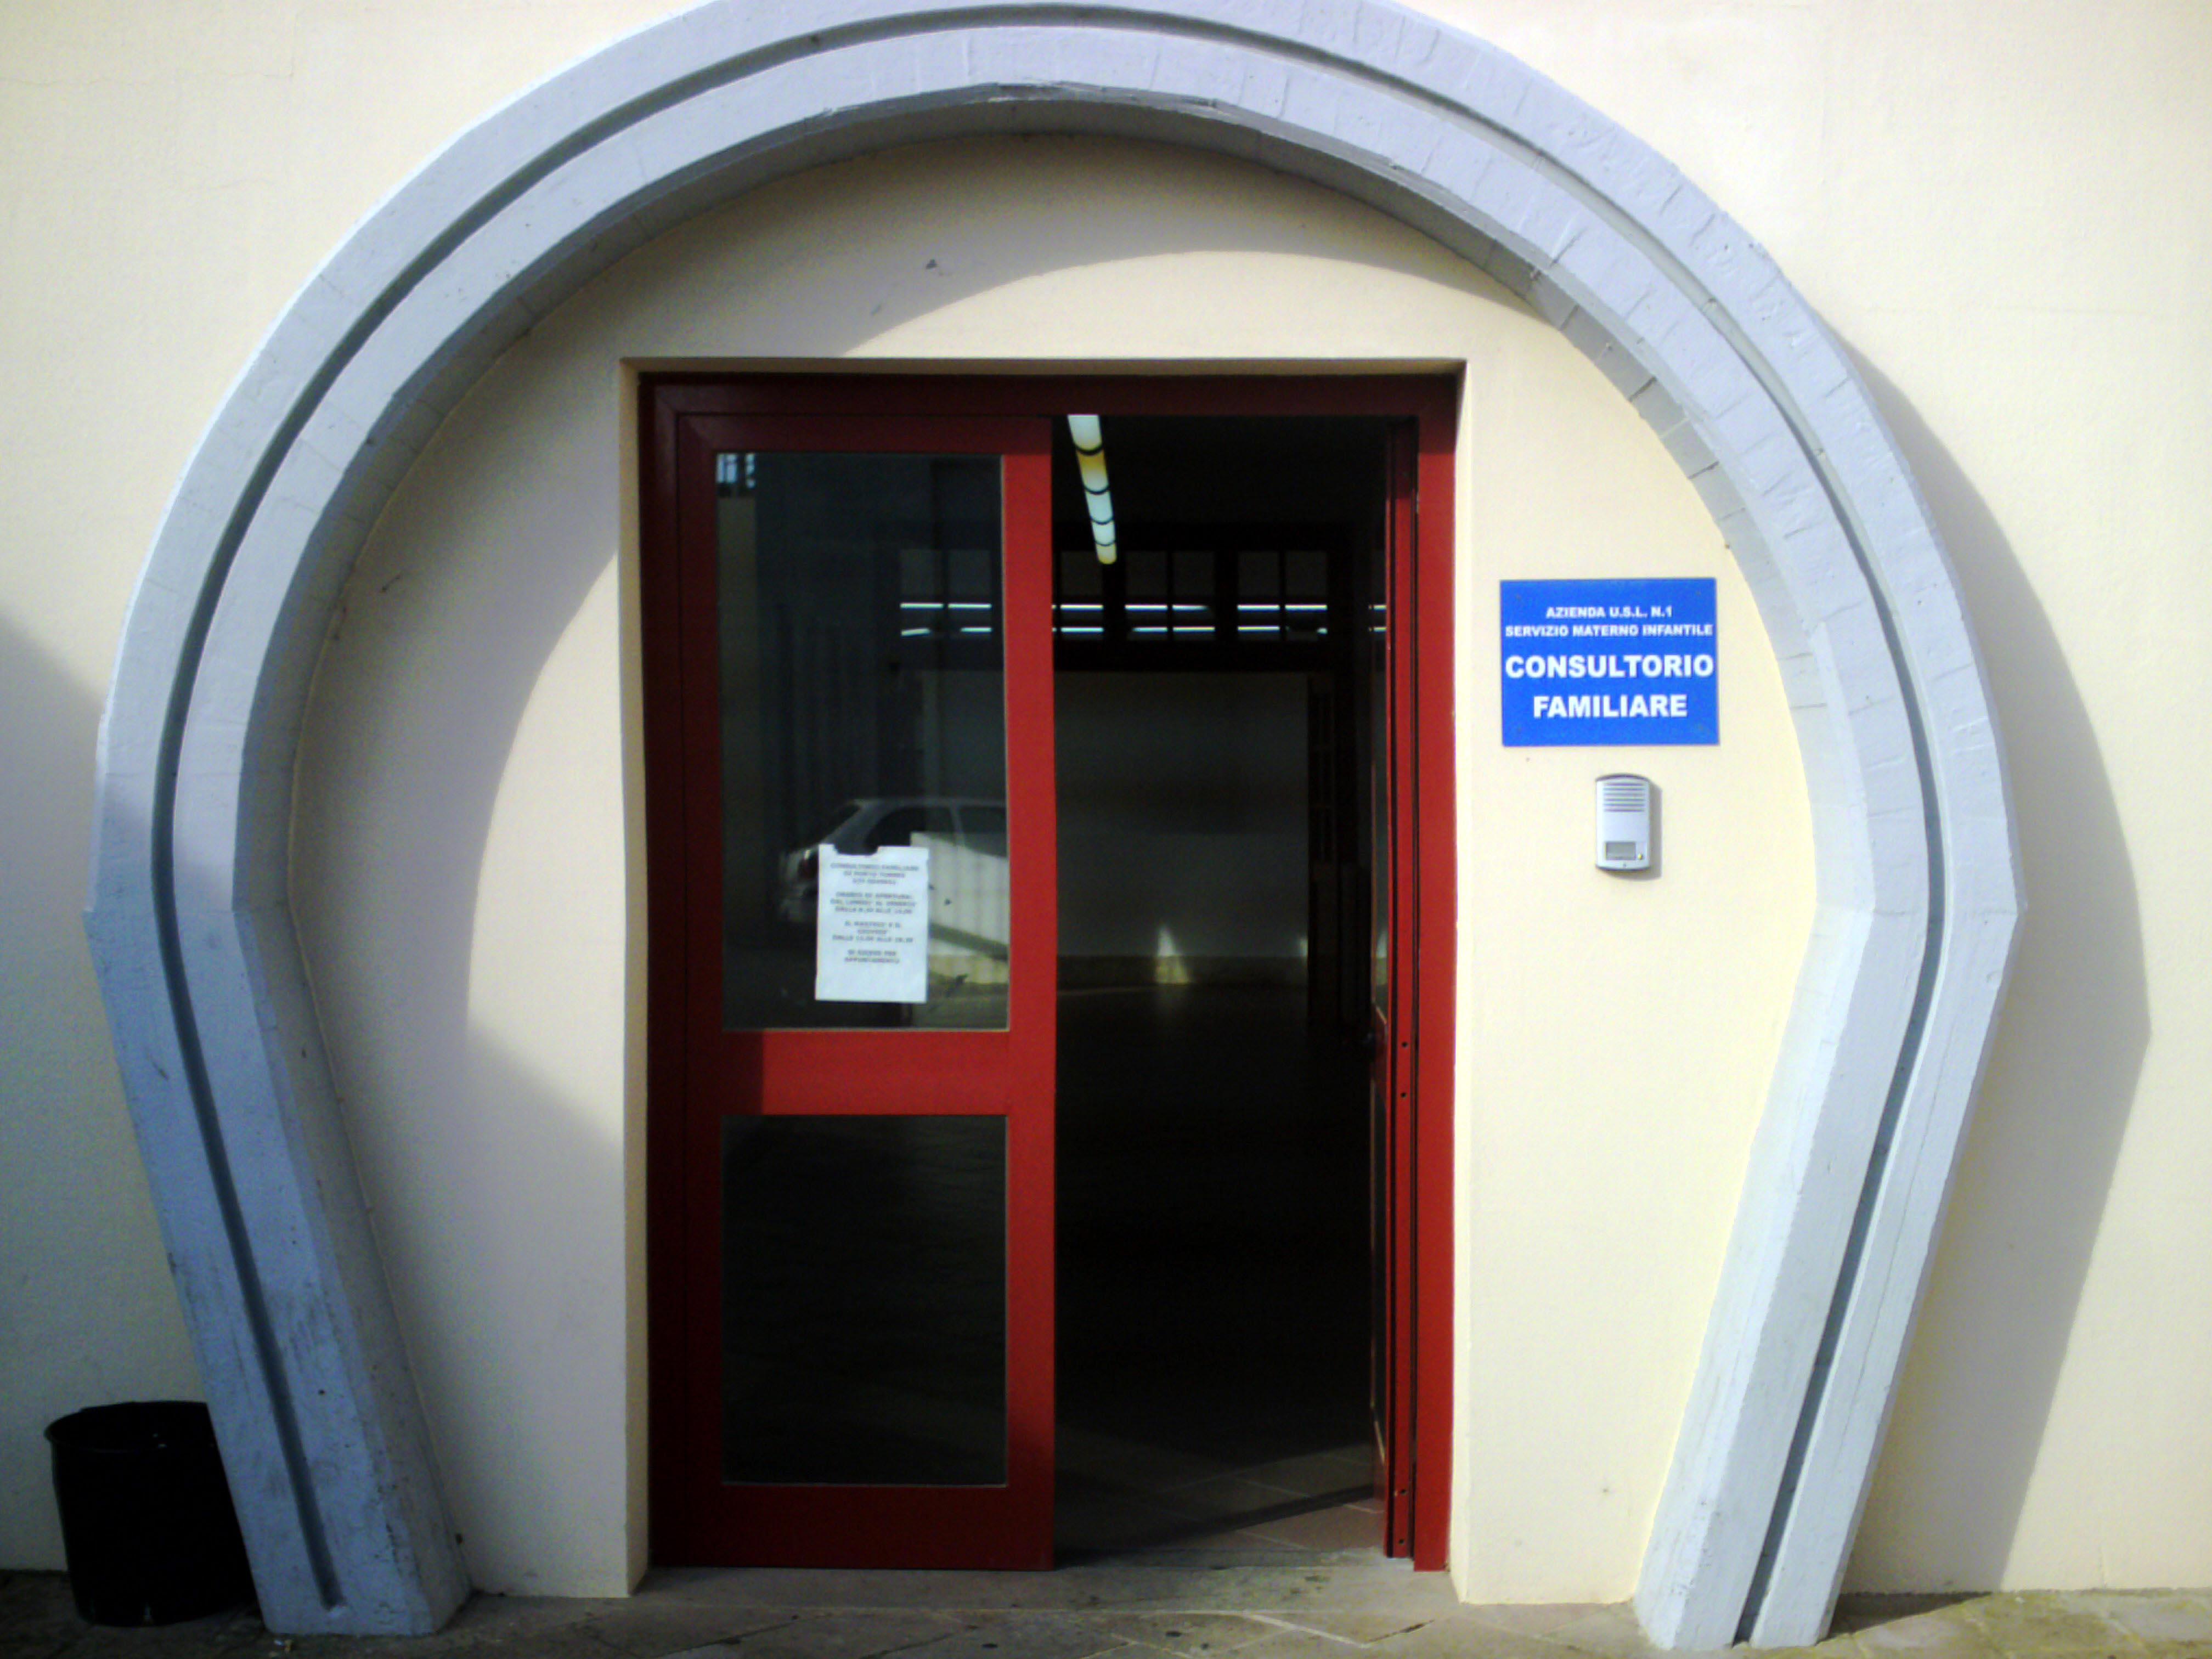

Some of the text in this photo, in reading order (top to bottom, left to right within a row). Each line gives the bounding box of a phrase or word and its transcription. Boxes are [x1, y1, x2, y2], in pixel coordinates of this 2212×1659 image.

[1546, 606, 1672, 618] AZIENDA U.S.L. N.1
[1505, 624, 1713, 637] SERVIZIO MATERNO INFANTILE
[1505, 654, 1714, 678] CONSULTORIO
[1533, 694, 1688, 718] FAMILIARE
